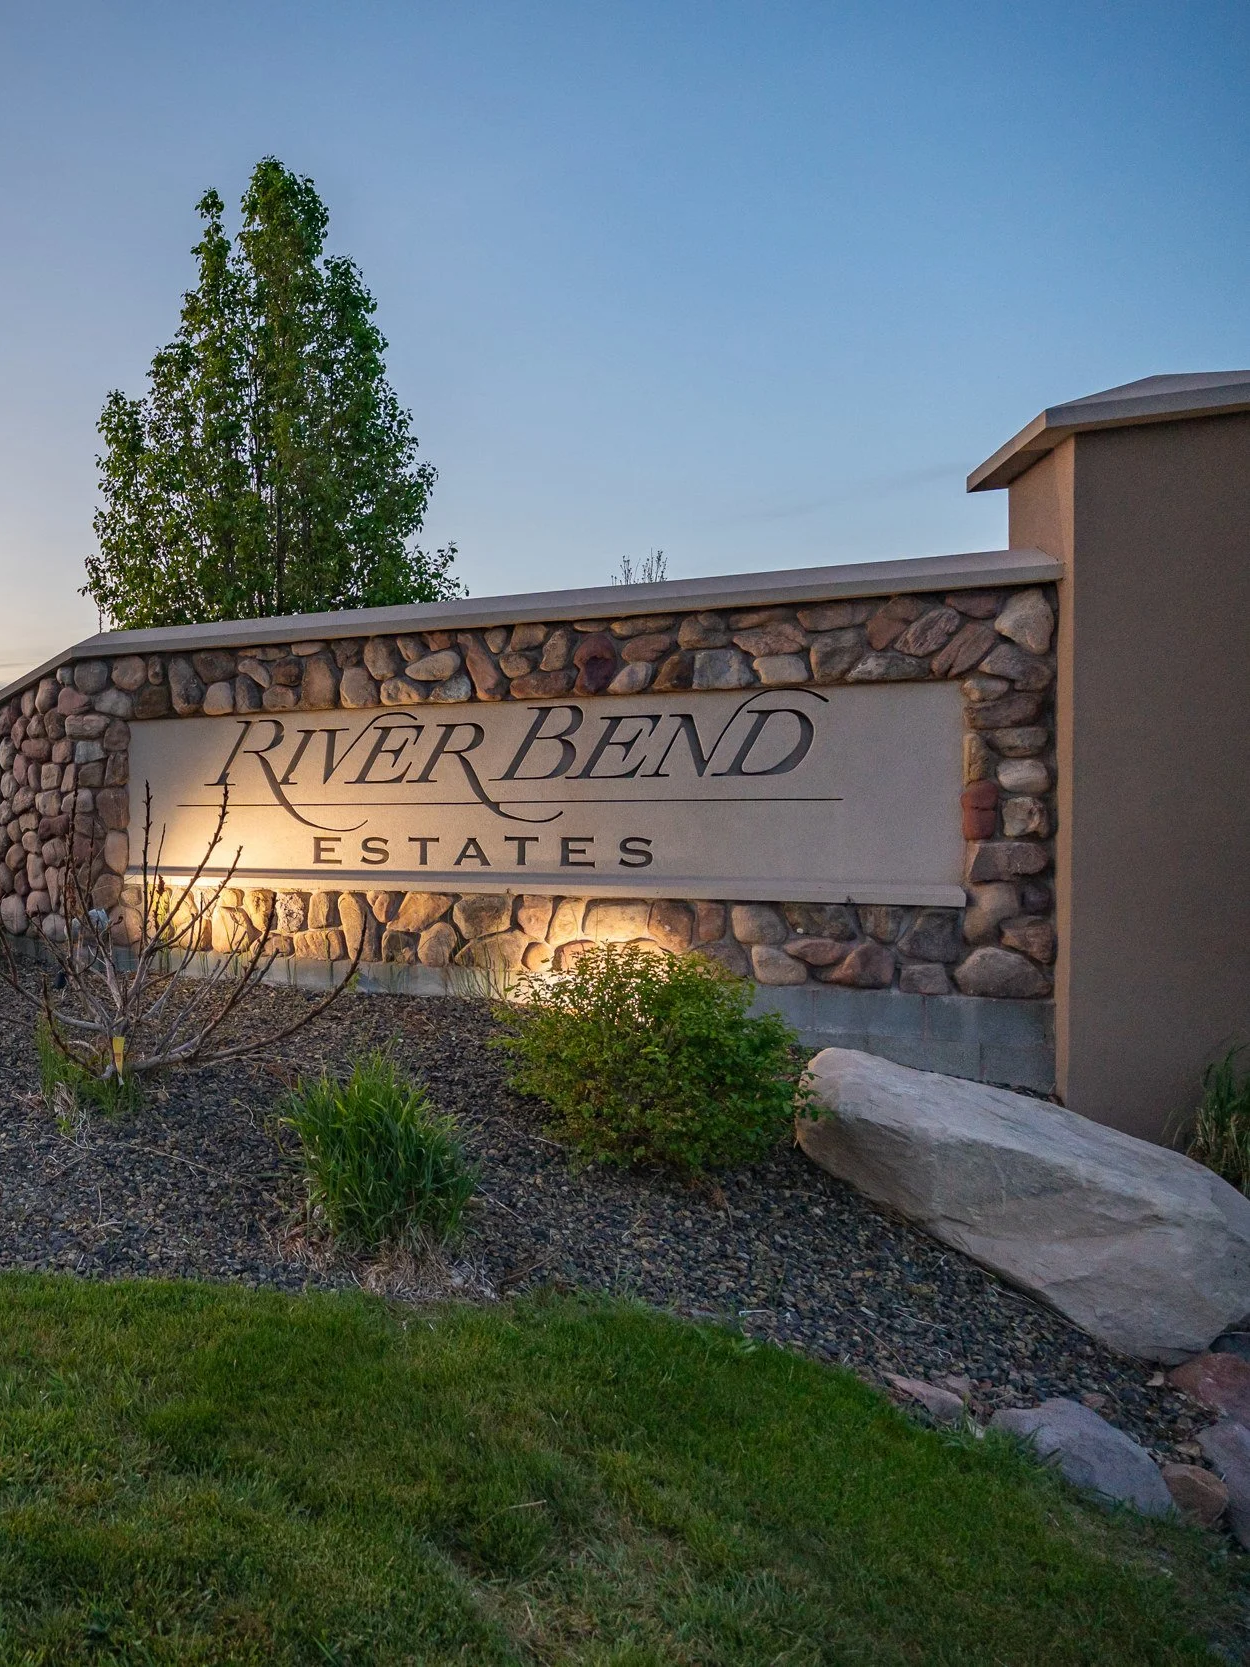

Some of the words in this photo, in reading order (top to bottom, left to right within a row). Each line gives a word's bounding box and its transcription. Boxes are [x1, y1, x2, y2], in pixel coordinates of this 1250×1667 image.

[204, 712, 563, 832] RIVER
[488, 688, 829, 781] BEND
[312, 834, 656, 869] ESTATES
